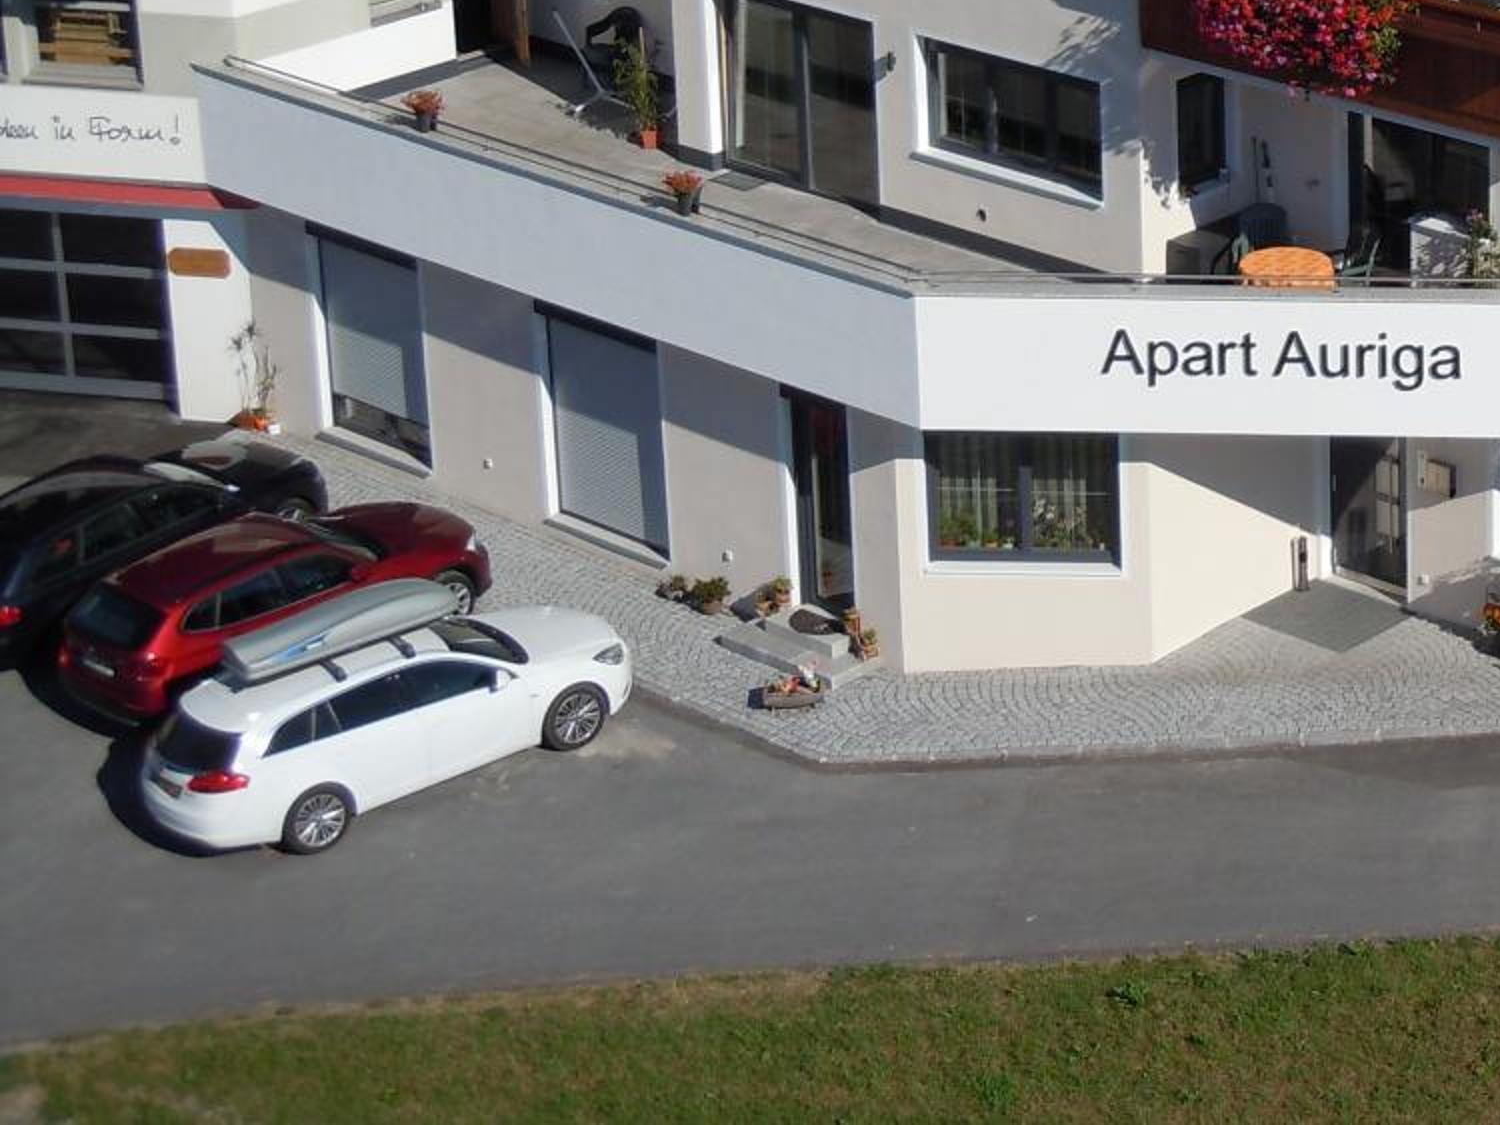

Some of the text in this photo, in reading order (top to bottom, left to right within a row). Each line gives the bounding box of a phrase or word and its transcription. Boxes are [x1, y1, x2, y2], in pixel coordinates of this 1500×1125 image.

[52, 114, 76, 140] in
[87, 114, 182, 146] Form!
[1100, 328, 1462, 391] Apart Auriga
